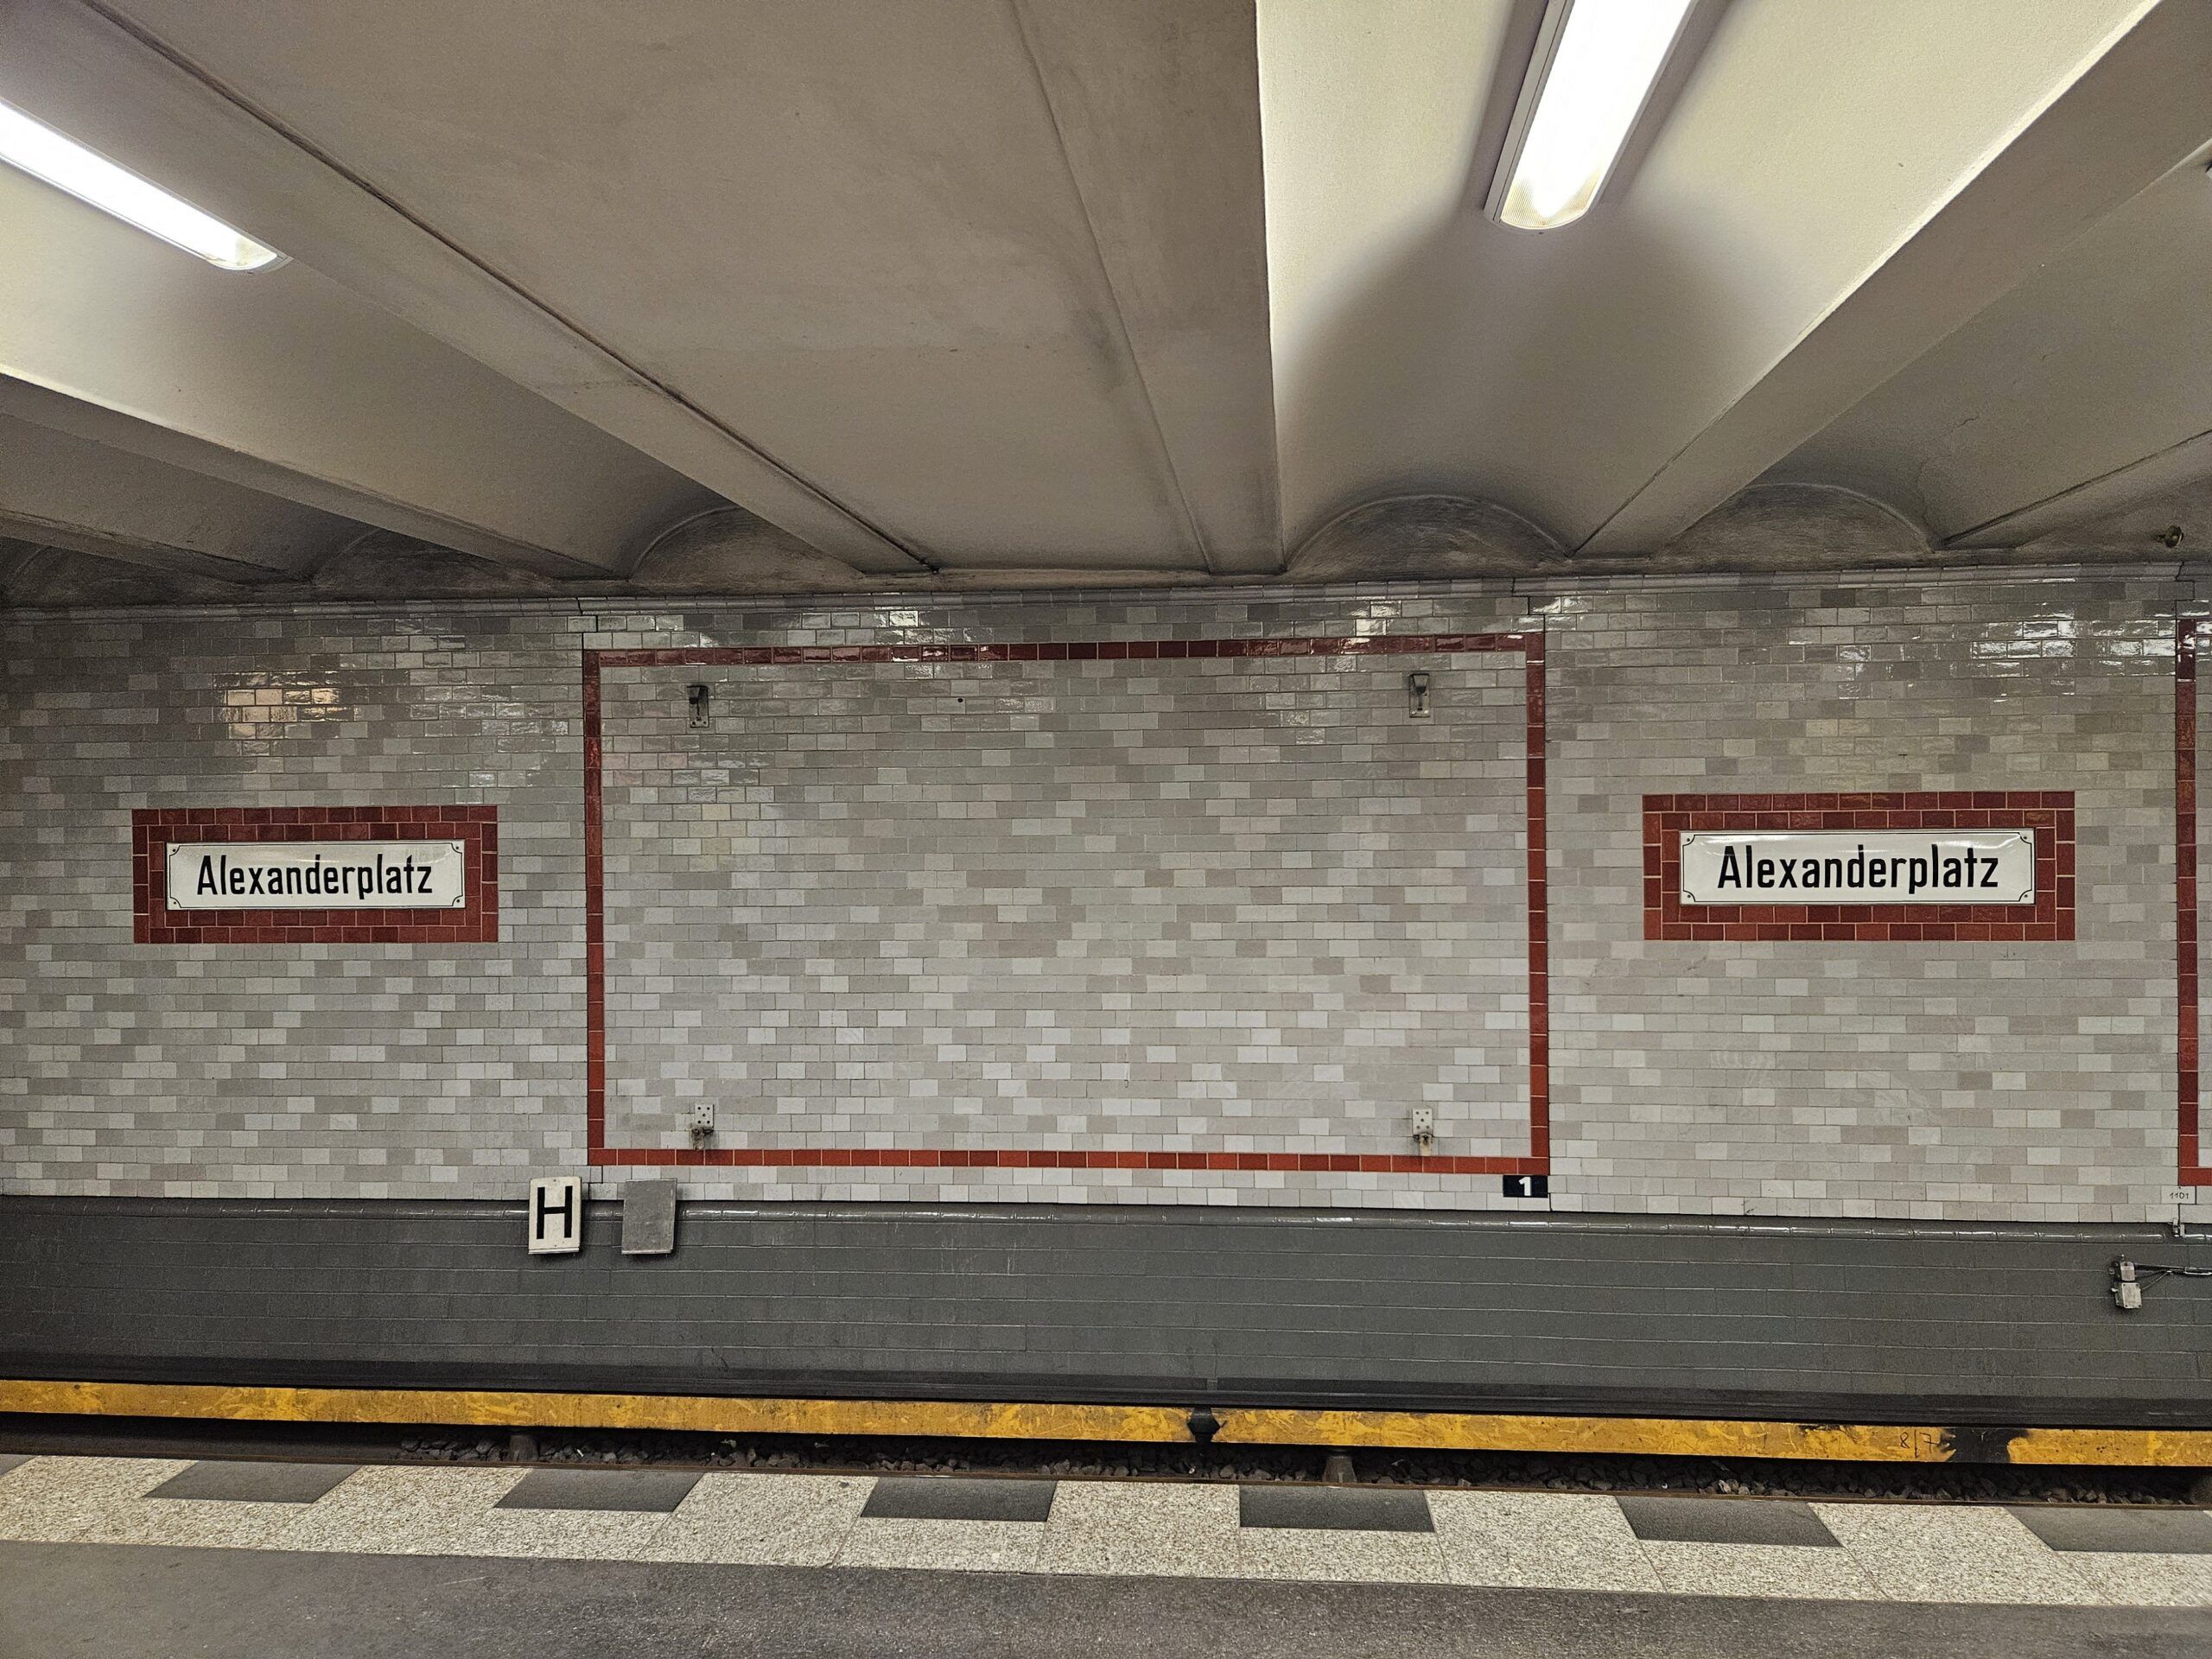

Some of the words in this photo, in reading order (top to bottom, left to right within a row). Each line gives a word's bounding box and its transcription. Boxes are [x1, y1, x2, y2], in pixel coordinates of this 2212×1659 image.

[196, 853, 434, 900] Alexanderplatz
[1718, 843, 1999, 895] Alexanderplatz
[1518, 1176, 1532, 1197] 1
[536, 1185, 574, 1240] H
